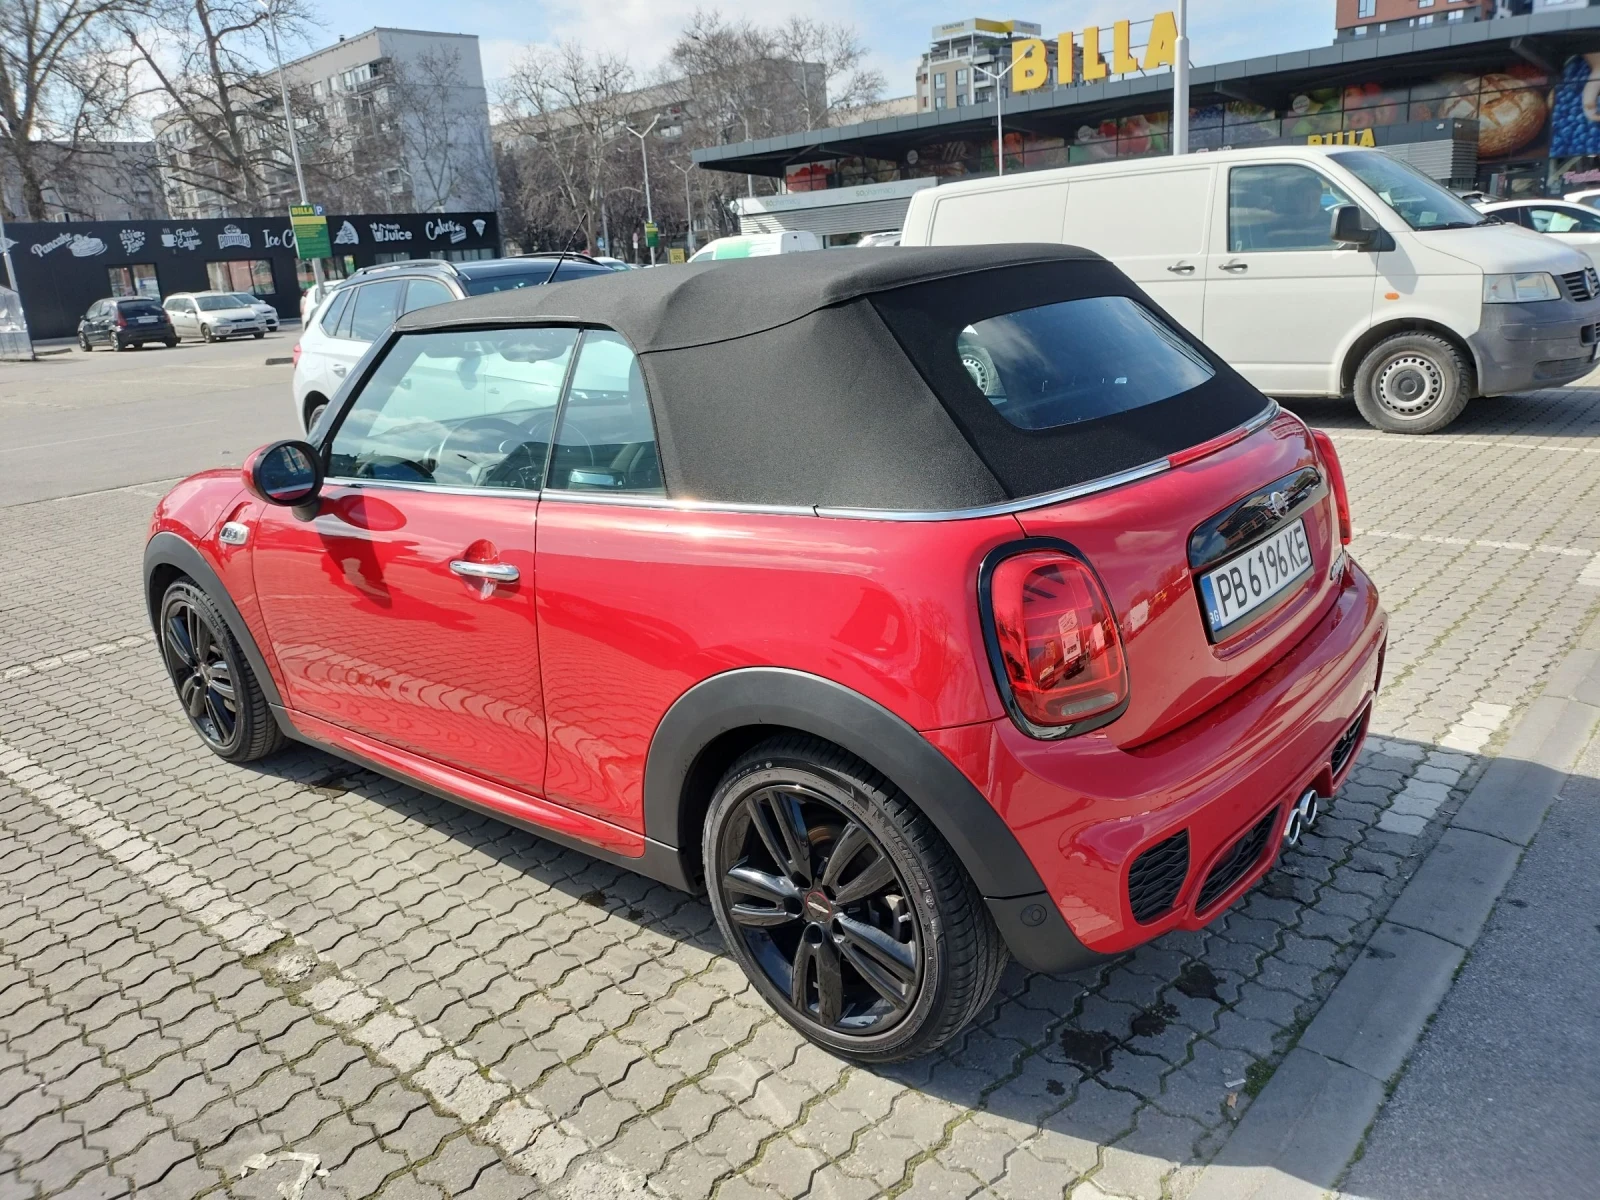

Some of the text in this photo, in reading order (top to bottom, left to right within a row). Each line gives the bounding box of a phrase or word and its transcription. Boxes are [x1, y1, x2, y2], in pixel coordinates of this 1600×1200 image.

[1012, 11, 1178, 93] BILLA
[262, 229, 281, 249] Ice
[383, 229, 412, 241] Juice
